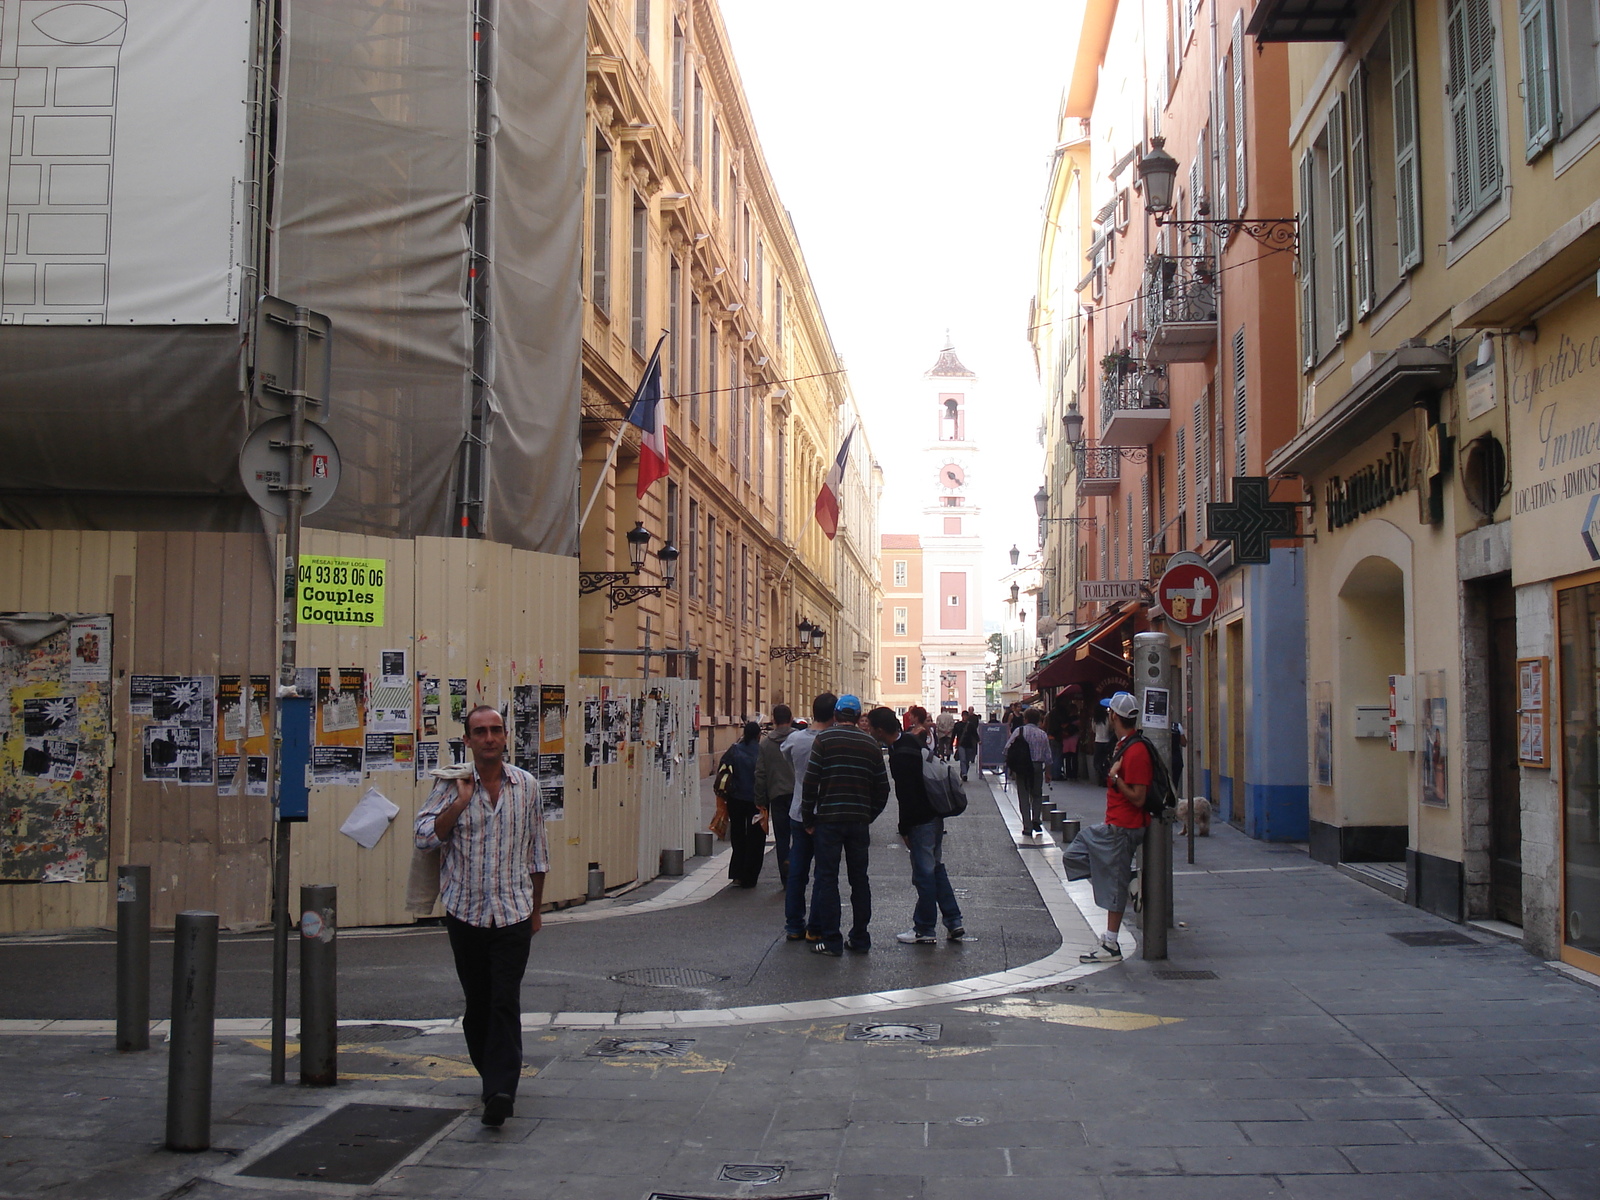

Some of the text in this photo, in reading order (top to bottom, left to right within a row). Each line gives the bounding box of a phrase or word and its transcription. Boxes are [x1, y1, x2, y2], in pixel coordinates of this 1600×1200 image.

[1514, 478, 1556, 515] LOCATIONS
[299, 565, 383, 587] 04 93 83 06 06
[303, 587, 374, 605] Couples
[1083, 583, 1137, 598] TOILETTAGE
[302, 606, 374, 624] Coquins
